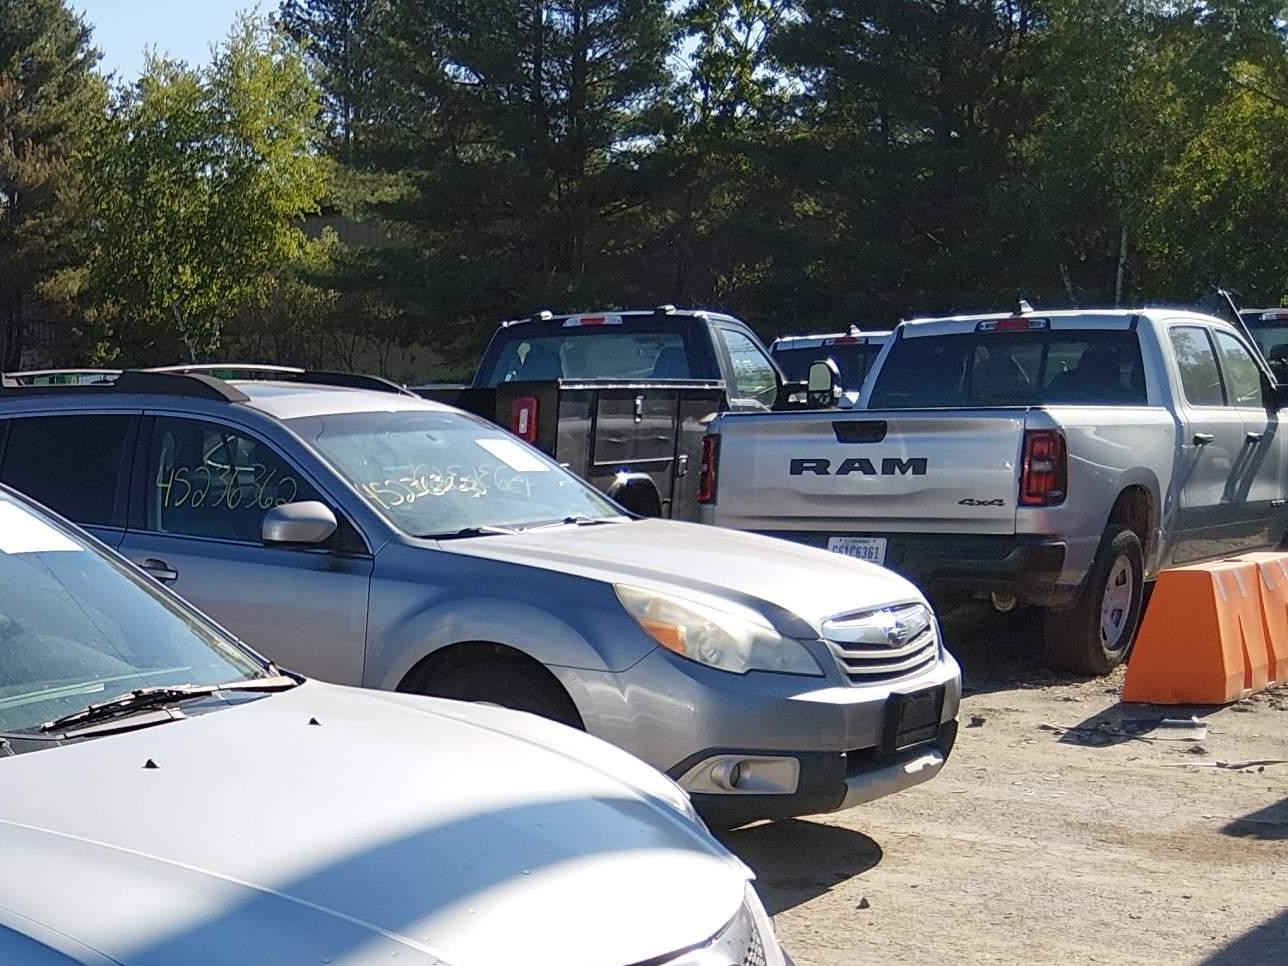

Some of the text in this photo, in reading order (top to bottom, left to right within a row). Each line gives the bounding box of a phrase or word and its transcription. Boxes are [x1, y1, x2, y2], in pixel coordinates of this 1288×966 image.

[789, 457, 929, 476] RAM
[157, 448, 297, 509] 45236362
[958, 498, 1005, 507] 4x4
